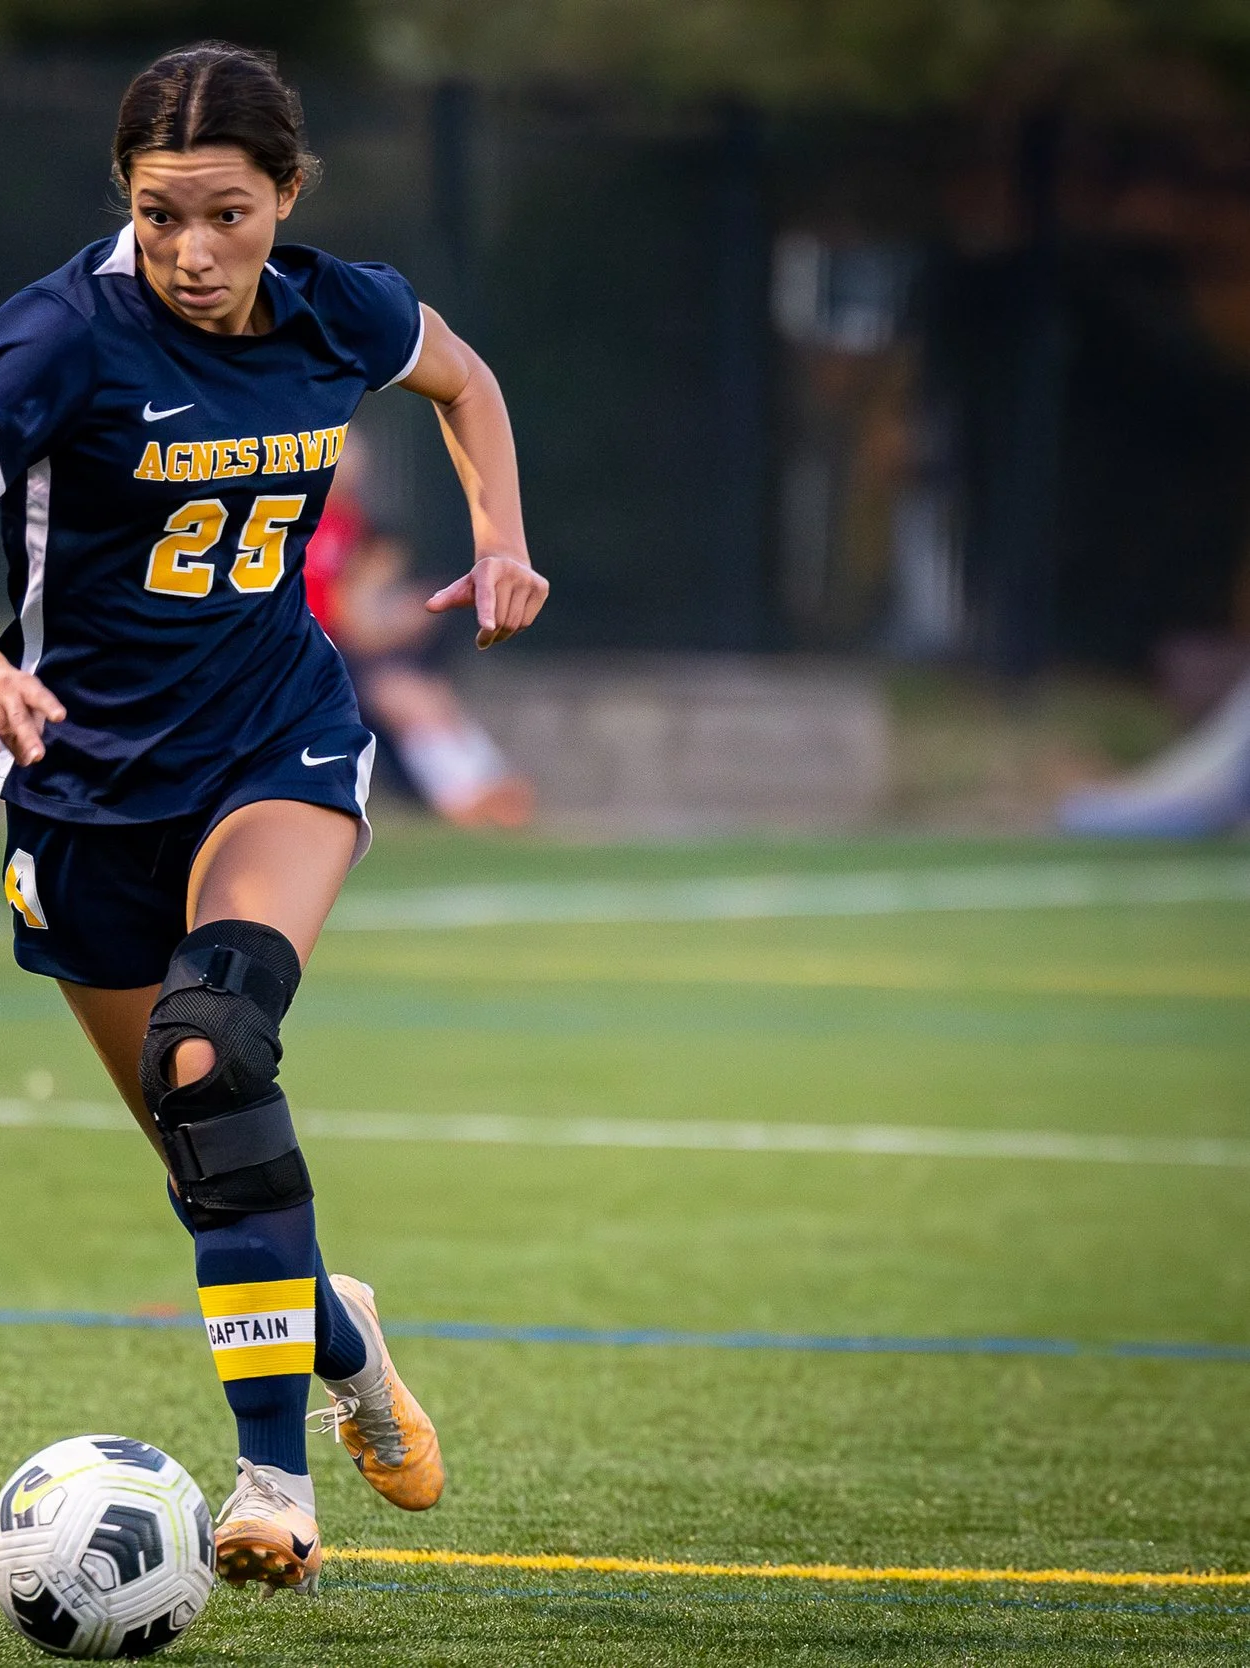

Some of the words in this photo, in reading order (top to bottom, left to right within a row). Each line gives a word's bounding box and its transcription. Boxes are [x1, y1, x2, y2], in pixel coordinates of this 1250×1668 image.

[134, 438, 258, 482] AGNES
[144, 494, 307, 598] 25
[209, 1317, 289, 1345] CAPTAIN
